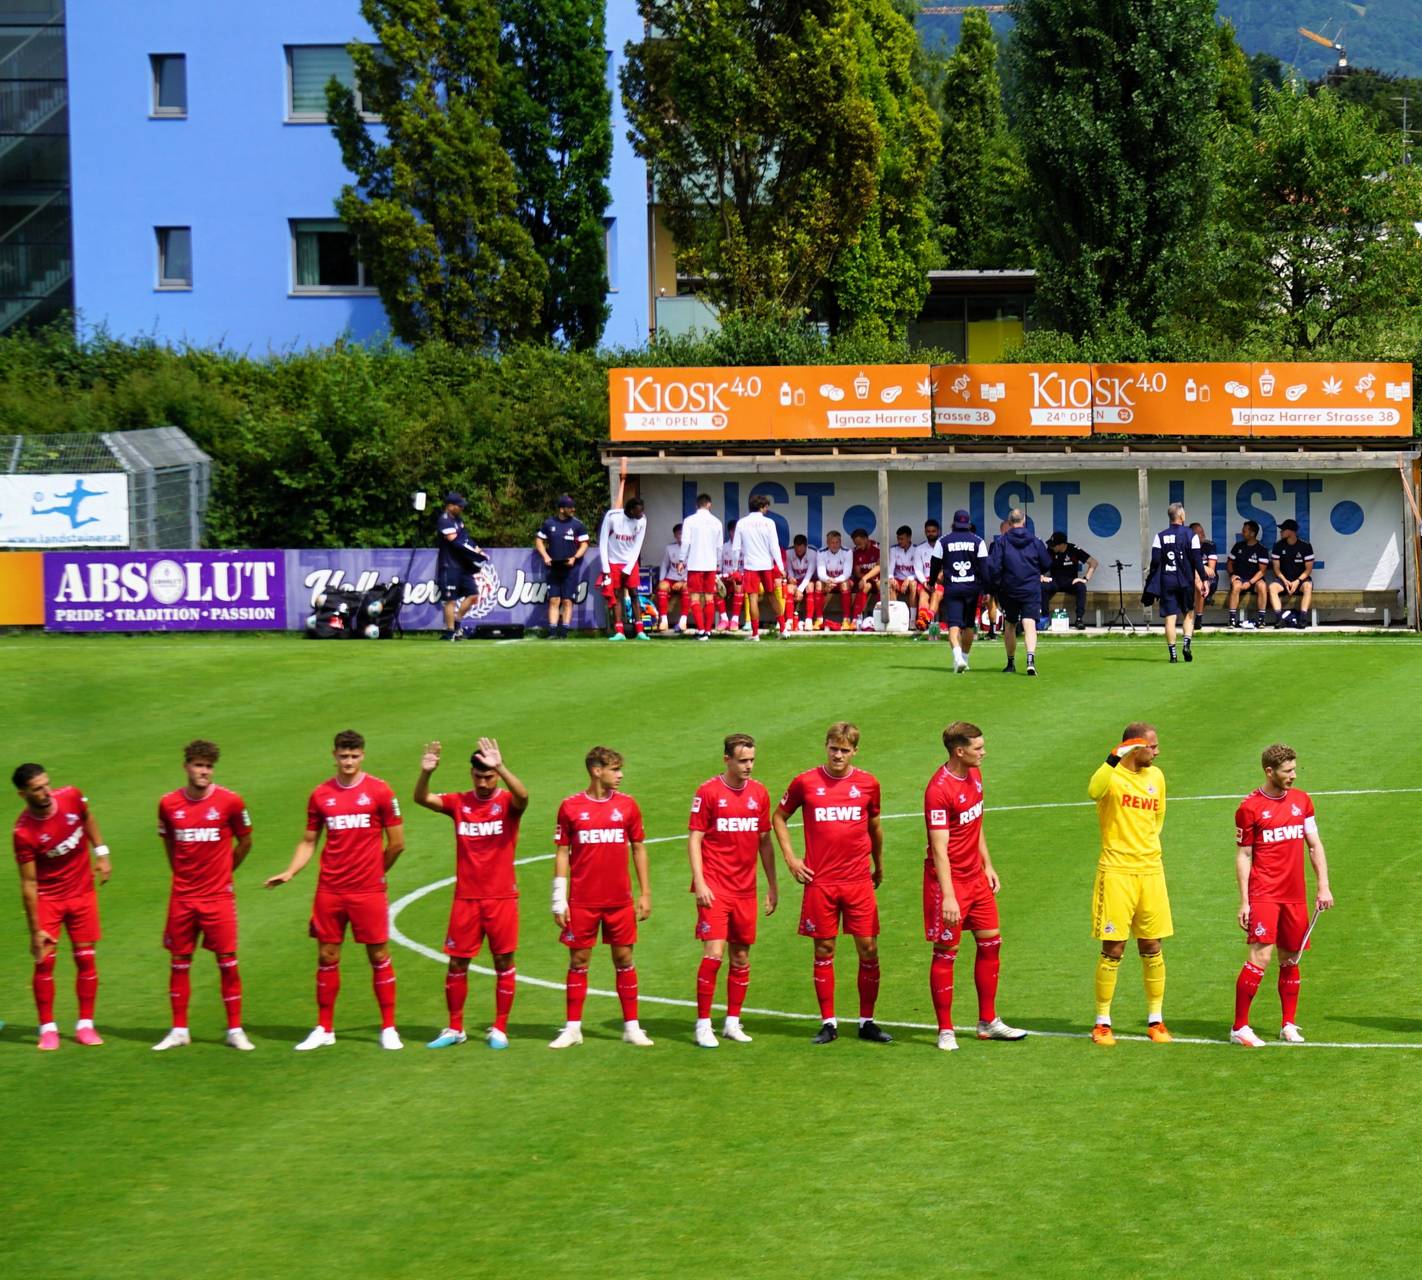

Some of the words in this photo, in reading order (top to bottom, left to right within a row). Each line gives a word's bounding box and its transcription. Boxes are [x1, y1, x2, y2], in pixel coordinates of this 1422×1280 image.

[623, 376, 731, 412] KIOSK
[730, 375, 763, 398] 4.0
[1028, 372, 1136, 408] KIOSK
[1135, 372, 1167, 393] 4.0
[665, 416, 698, 427] OPEN
[834, 413, 871, 427] Ignaz
[875, 412, 917, 424] Harrer
[975, 410, 990, 422] 38
[1069, 410, 1105, 422] OPEN
[1238, 411, 1275, 425] Ignaz
[1279, 411, 1323, 422] Harrer
[1326, 411, 1374, 422] Strasse
[1378, 411, 1394, 422] 38
[948, 541, 975, 552] REWE
[54, 608, 105, 622] PRIDE
[113, 607, 200, 622] TRADITION
[209, 607, 276, 621] PASSION
[1121, 793, 1159, 812] REWE
[814, 806, 862, 822] REWE
[959, 800, 984, 825] REW
[327, 814, 371, 830] REWE
[458, 821, 504, 836] REWE
[717, 817, 759, 833] REWE
[175, 828, 221, 842] REWE
[579, 829, 625, 844] REWE
[1262, 824, 1304, 843] REWE
